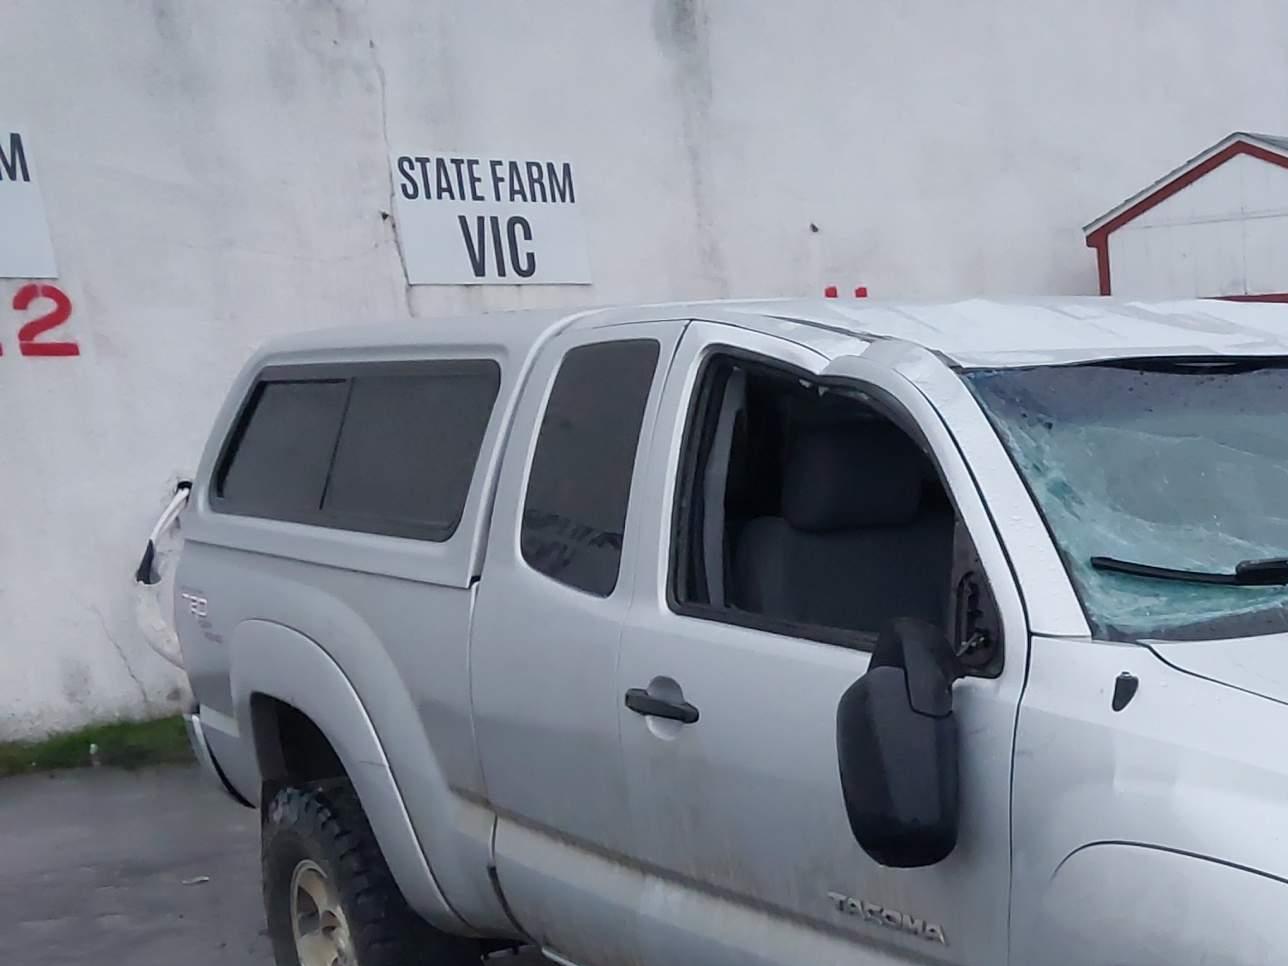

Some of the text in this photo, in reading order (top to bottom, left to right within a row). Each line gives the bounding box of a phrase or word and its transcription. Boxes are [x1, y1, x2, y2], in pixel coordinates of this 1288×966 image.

[397, 156, 576, 203] STATE FARM
[458, 215, 536, 278] VIC
[827, 890, 949, 946] TACOMA
